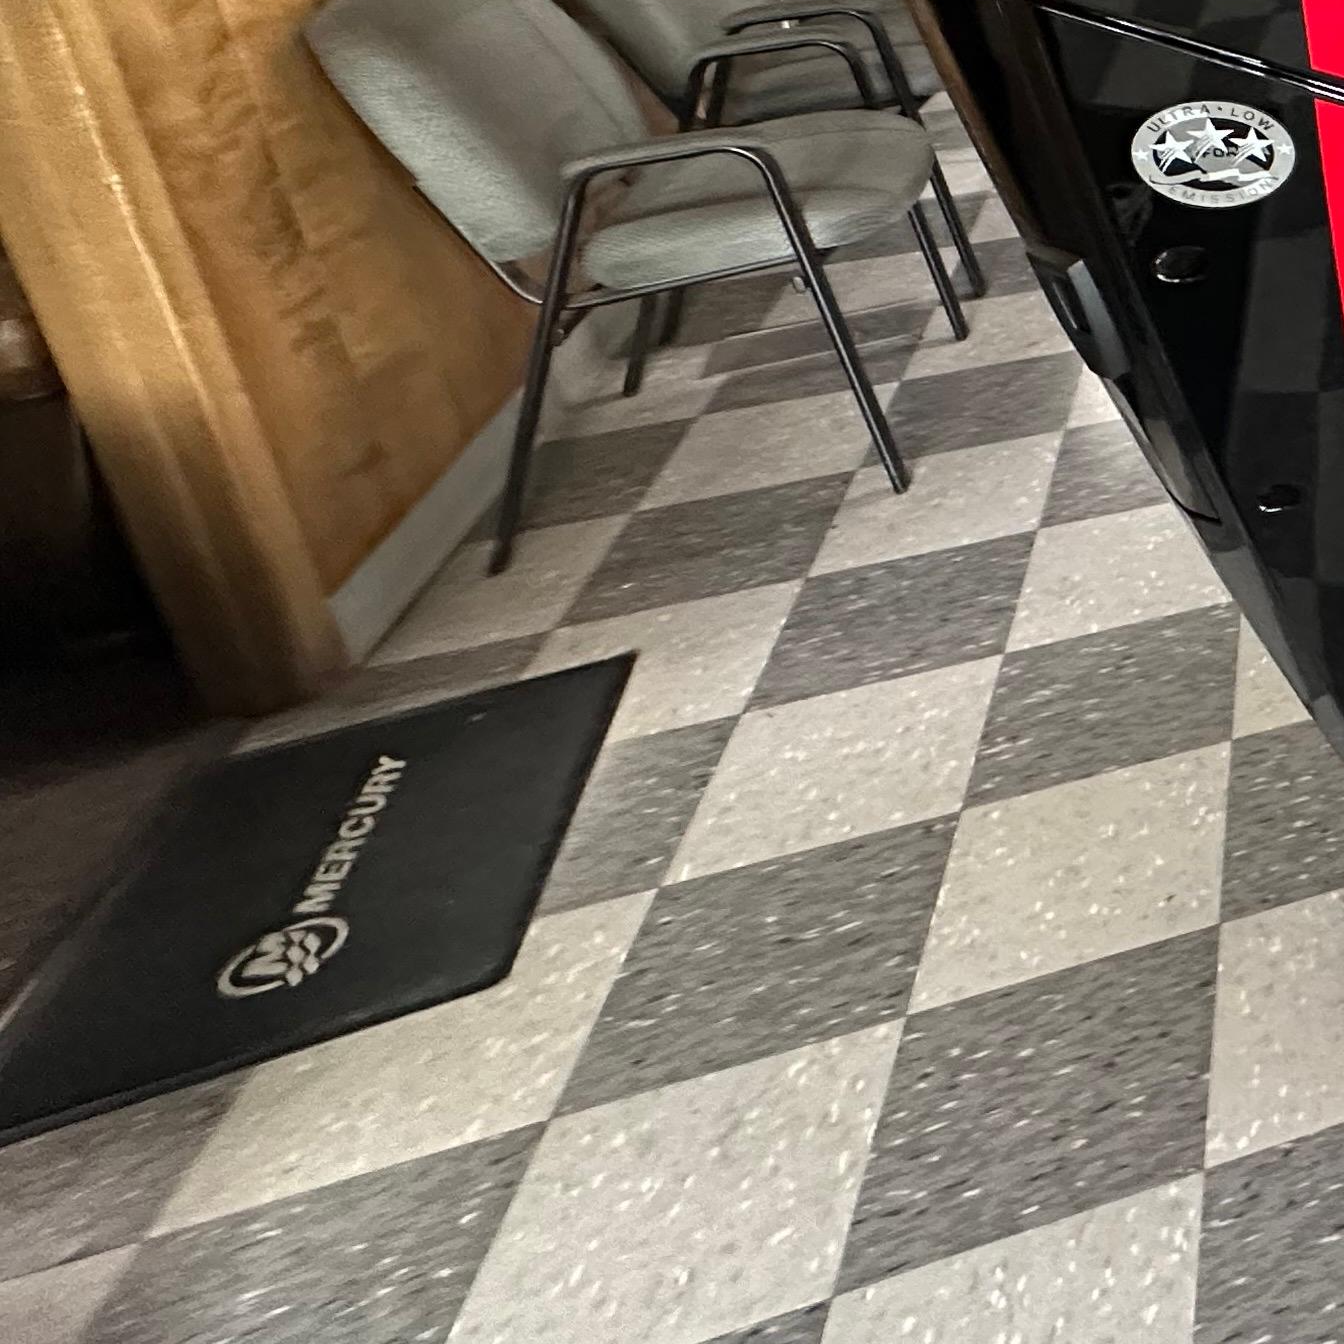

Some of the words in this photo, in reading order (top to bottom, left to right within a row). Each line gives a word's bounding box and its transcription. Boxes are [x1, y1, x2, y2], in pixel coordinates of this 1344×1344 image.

[1146, 103, 1211, 134] ULTRA
[1230, 107, 1276, 132] LOW
[292, 755, 407, 913] MERCURY
